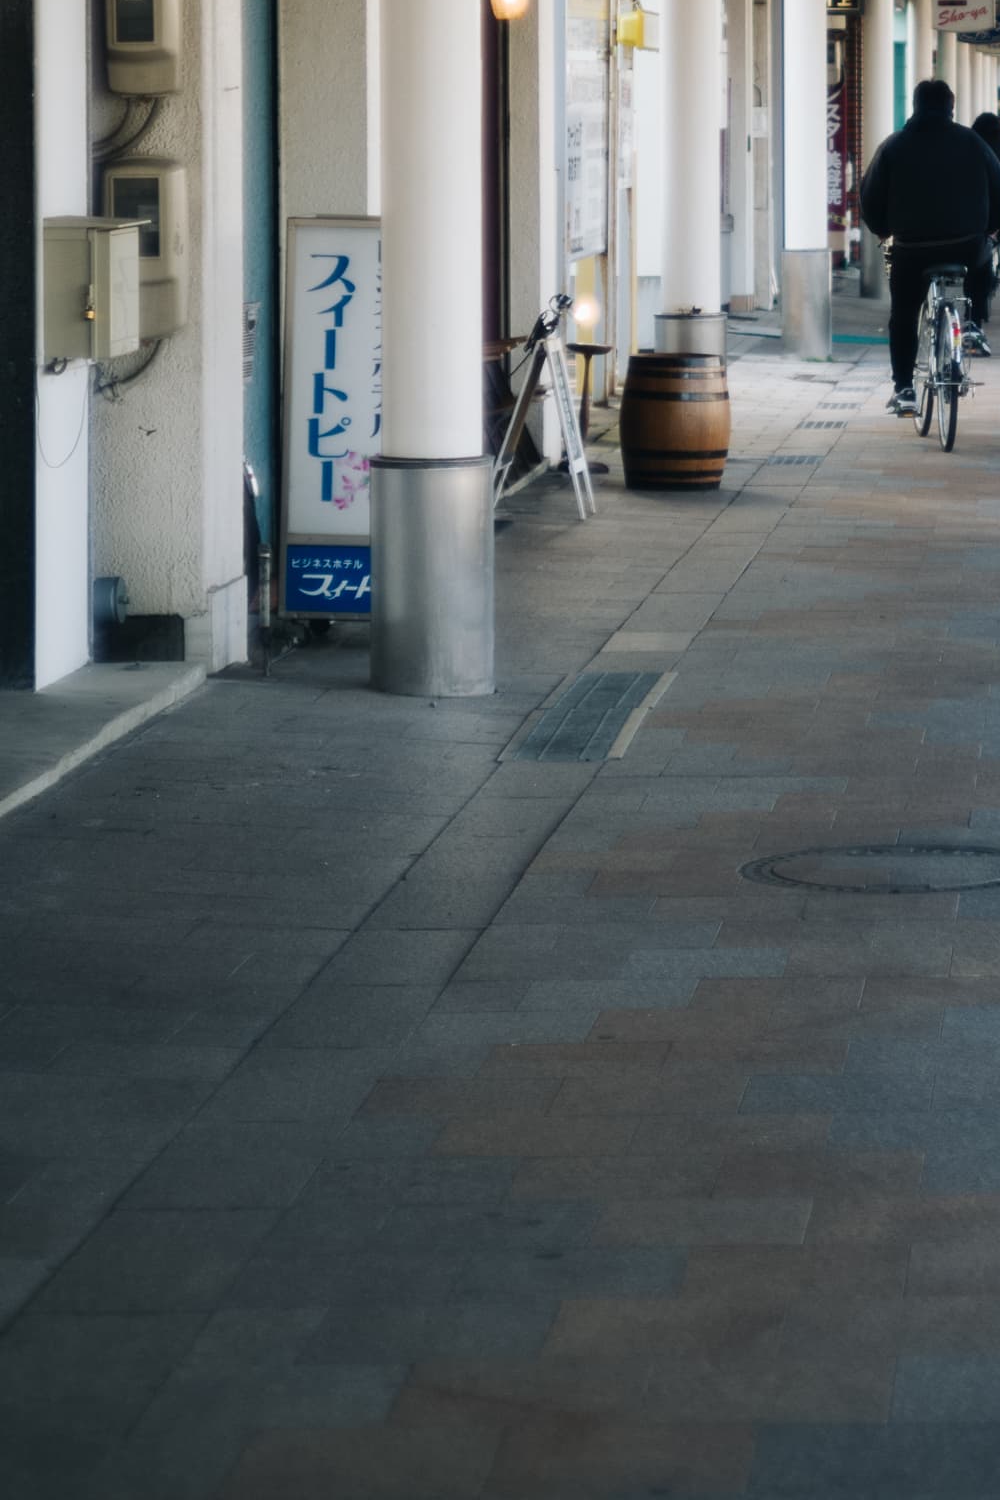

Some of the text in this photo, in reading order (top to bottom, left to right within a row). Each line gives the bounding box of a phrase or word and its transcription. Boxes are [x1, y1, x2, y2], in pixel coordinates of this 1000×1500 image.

[937, 5, 989, 26] Sho-ya
[291, 558, 363, 570] ビジネスホテル
